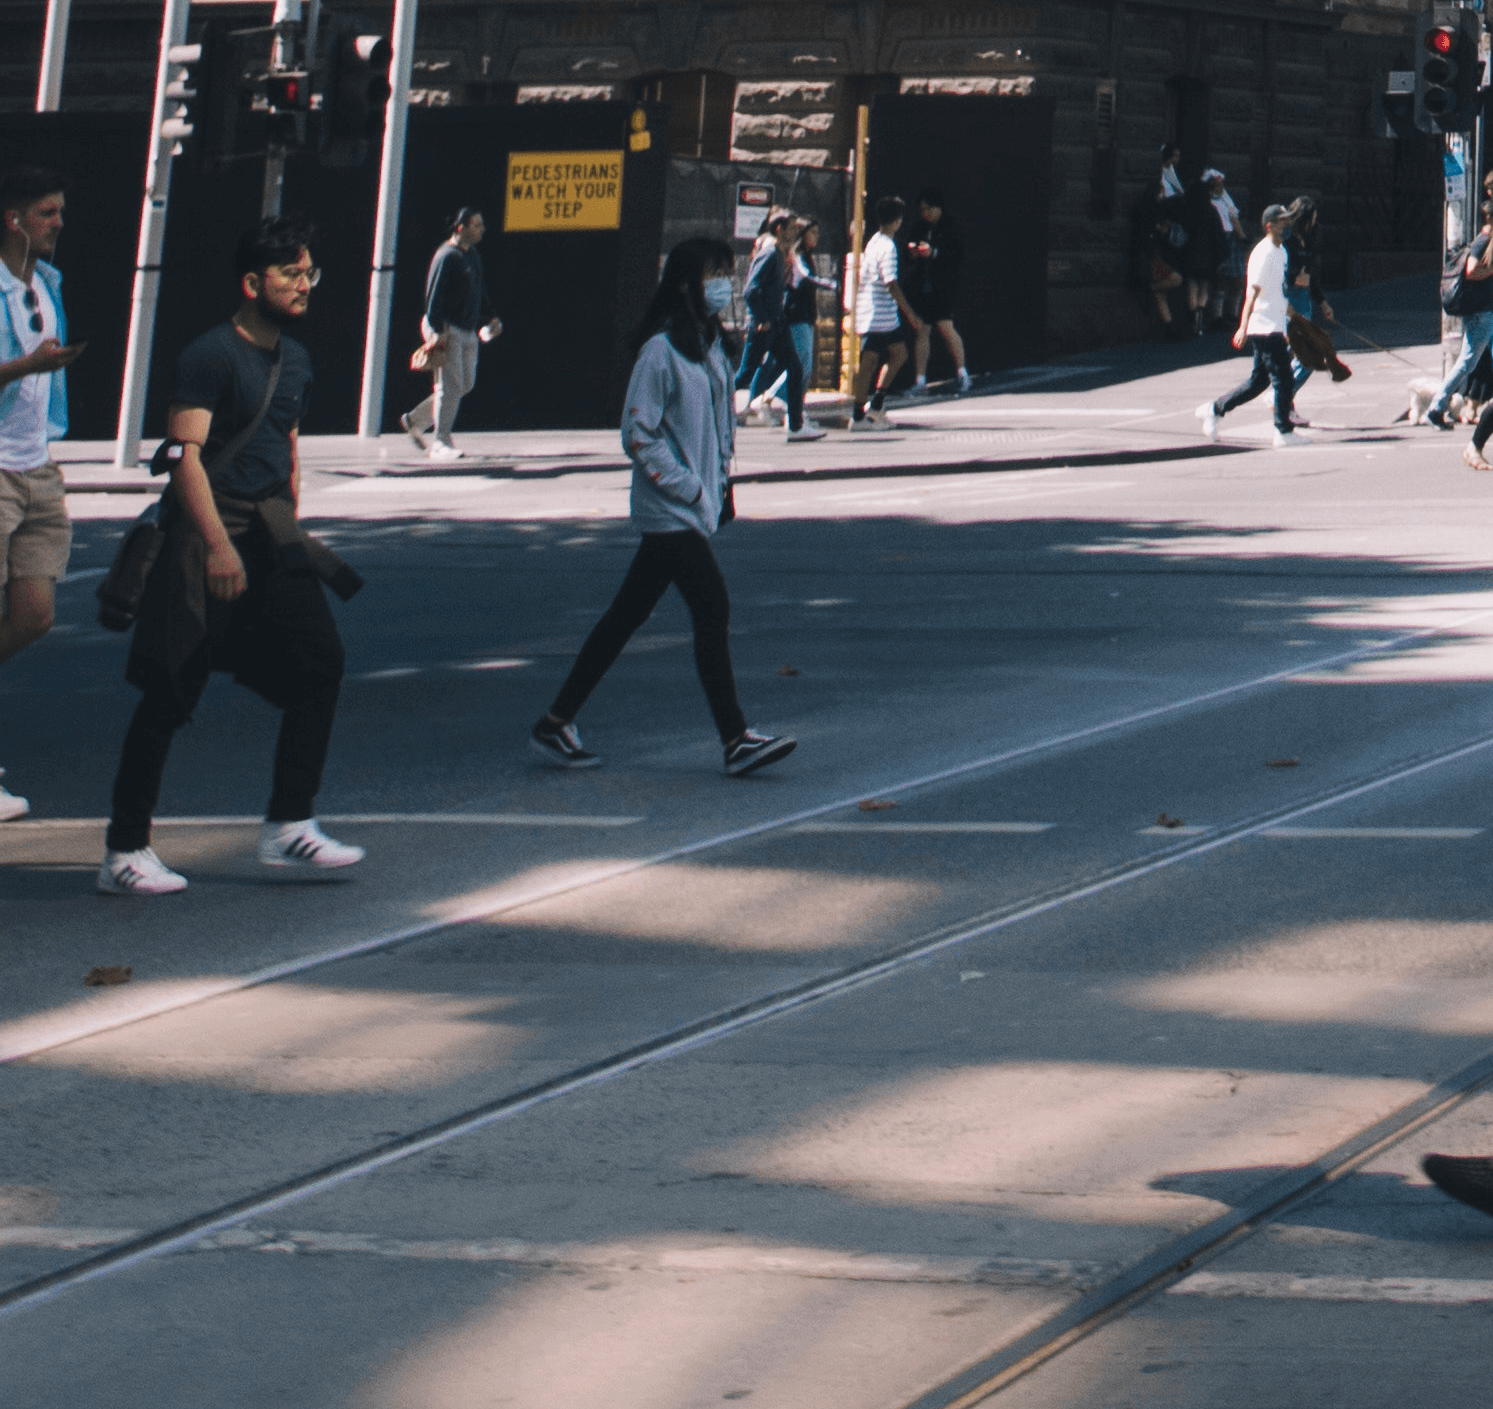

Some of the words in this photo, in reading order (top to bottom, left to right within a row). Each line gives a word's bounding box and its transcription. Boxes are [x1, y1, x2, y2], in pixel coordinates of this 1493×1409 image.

[511, 163, 619, 181] PEDESTRIANS
[511, 182, 567, 200] WATCH
[574, 181, 617, 199] YOUR
[543, 201, 583, 220] STEP
